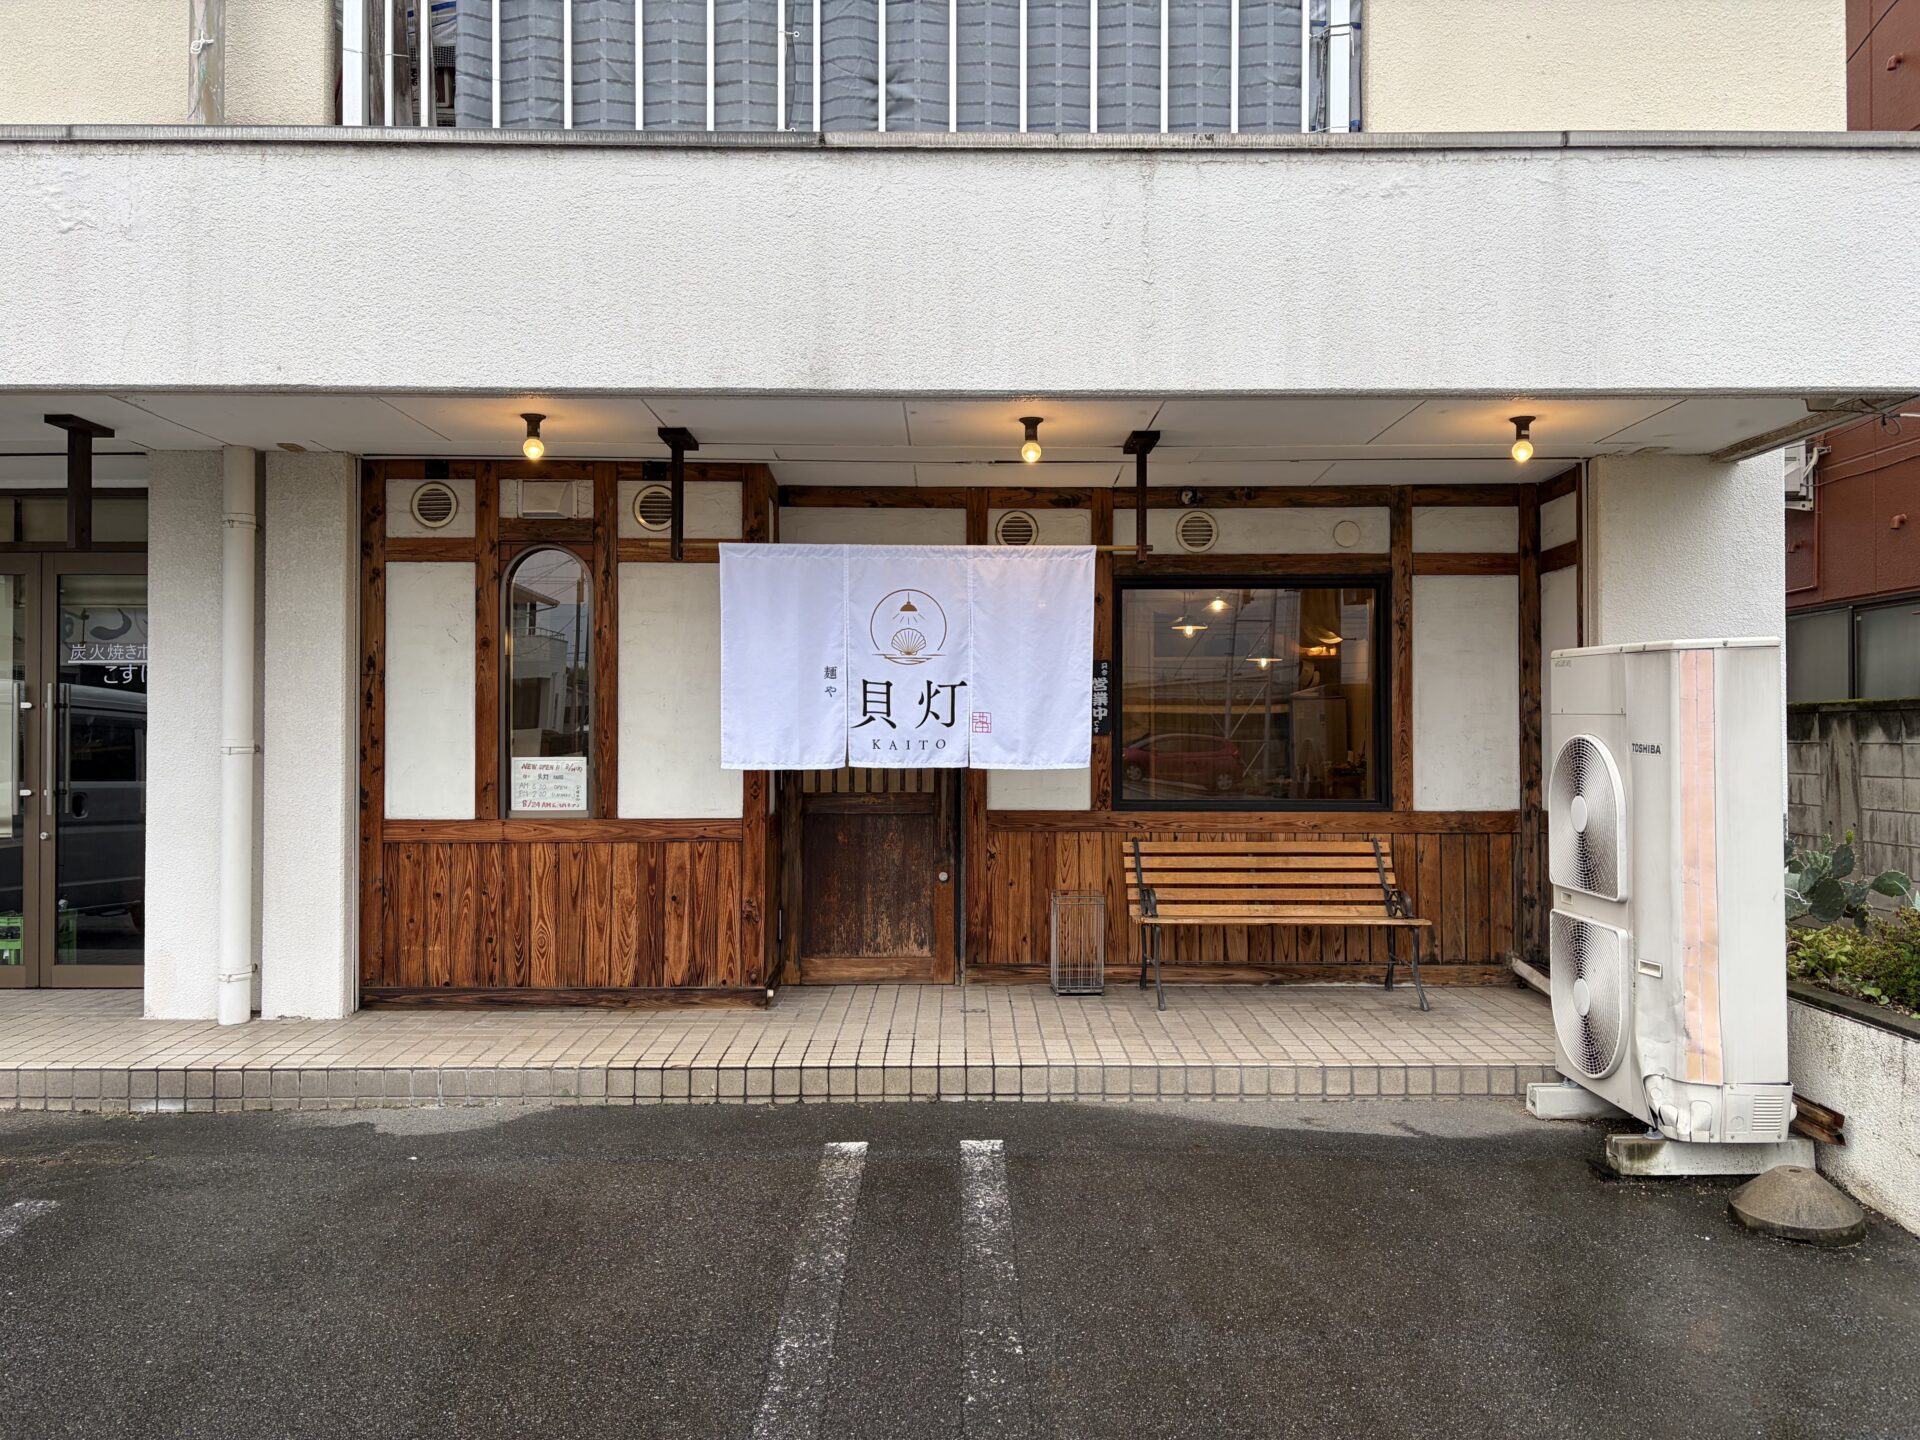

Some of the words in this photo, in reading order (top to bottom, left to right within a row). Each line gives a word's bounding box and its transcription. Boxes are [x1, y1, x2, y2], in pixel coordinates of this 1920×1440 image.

[823, 665, 838, 698] 麺や
[850, 678, 968, 730] 貝灯
[872, 738, 946, 751] KAITO
[1631, 742, 1662, 755] TOSHIBA
